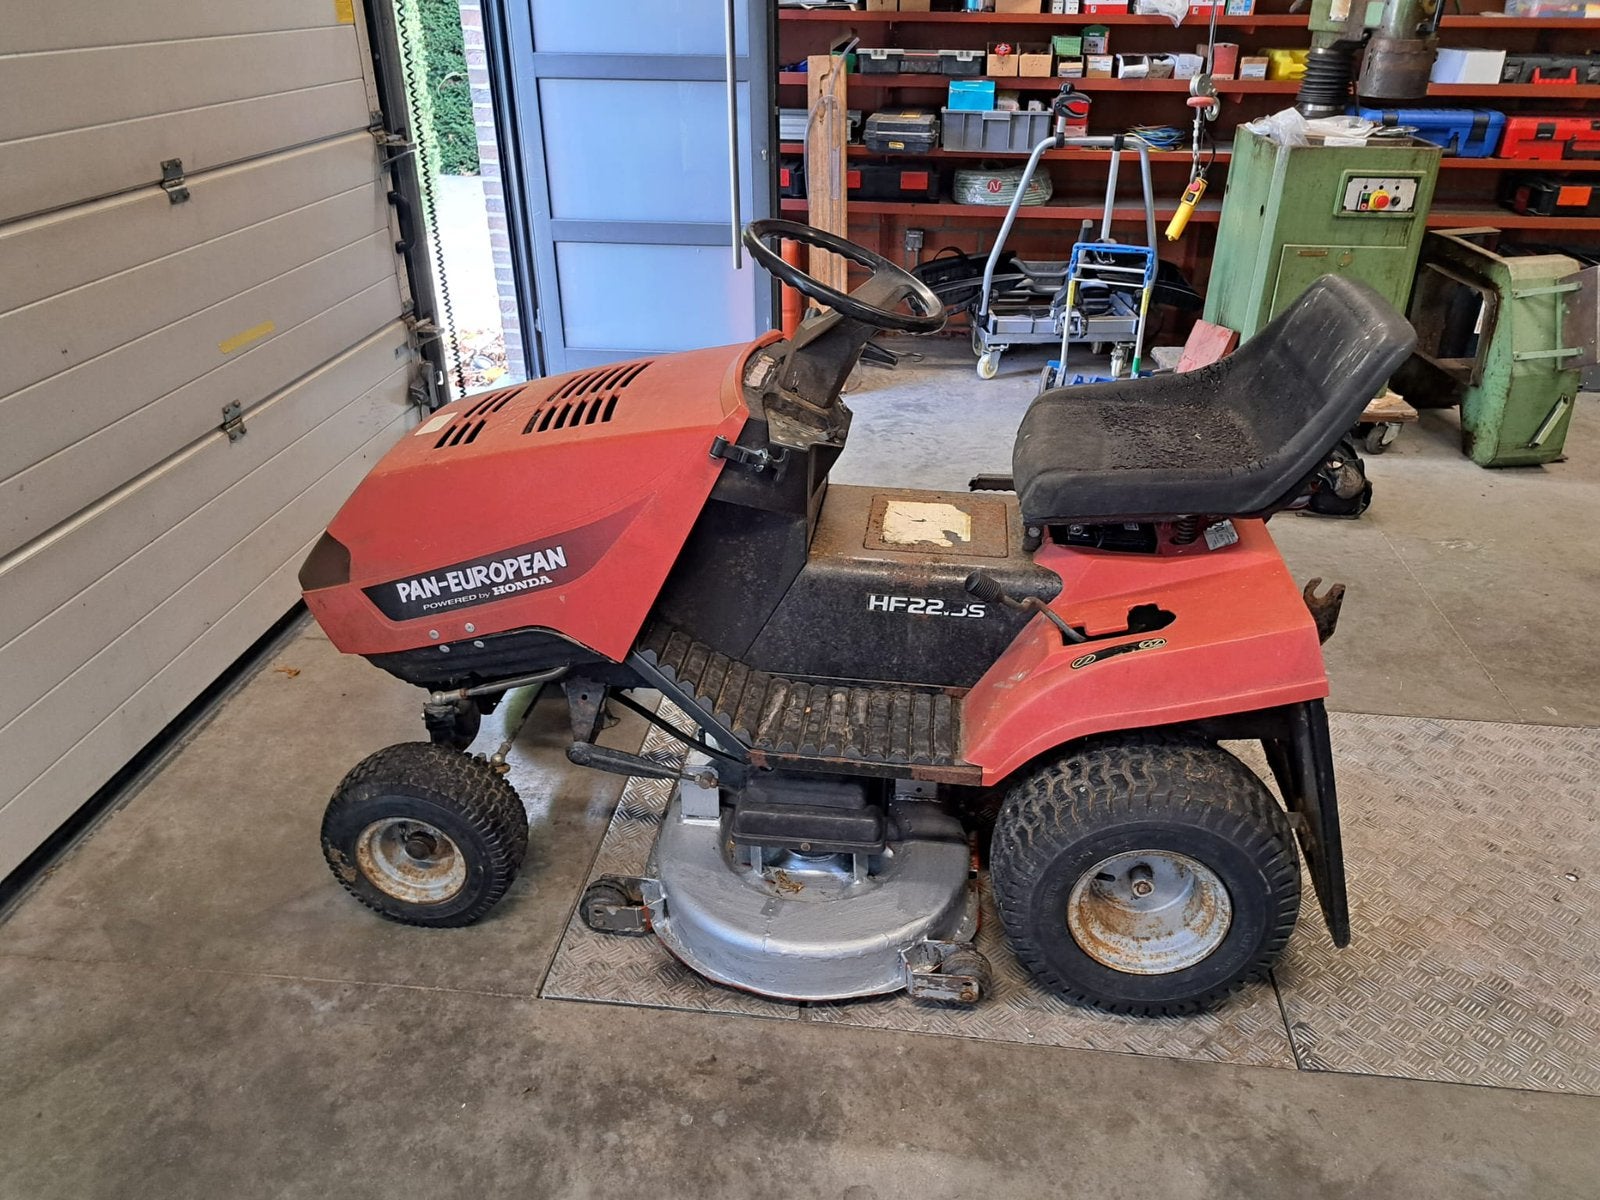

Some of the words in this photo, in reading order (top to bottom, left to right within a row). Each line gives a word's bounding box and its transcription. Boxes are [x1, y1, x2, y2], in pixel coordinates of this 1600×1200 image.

[396, 546, 567, 603] PAN-EUROPEAN
[423, 594, 477, 610] POWERED
[479, 591, 491, 600] by
[492, 575, 553, 596] HONDA
